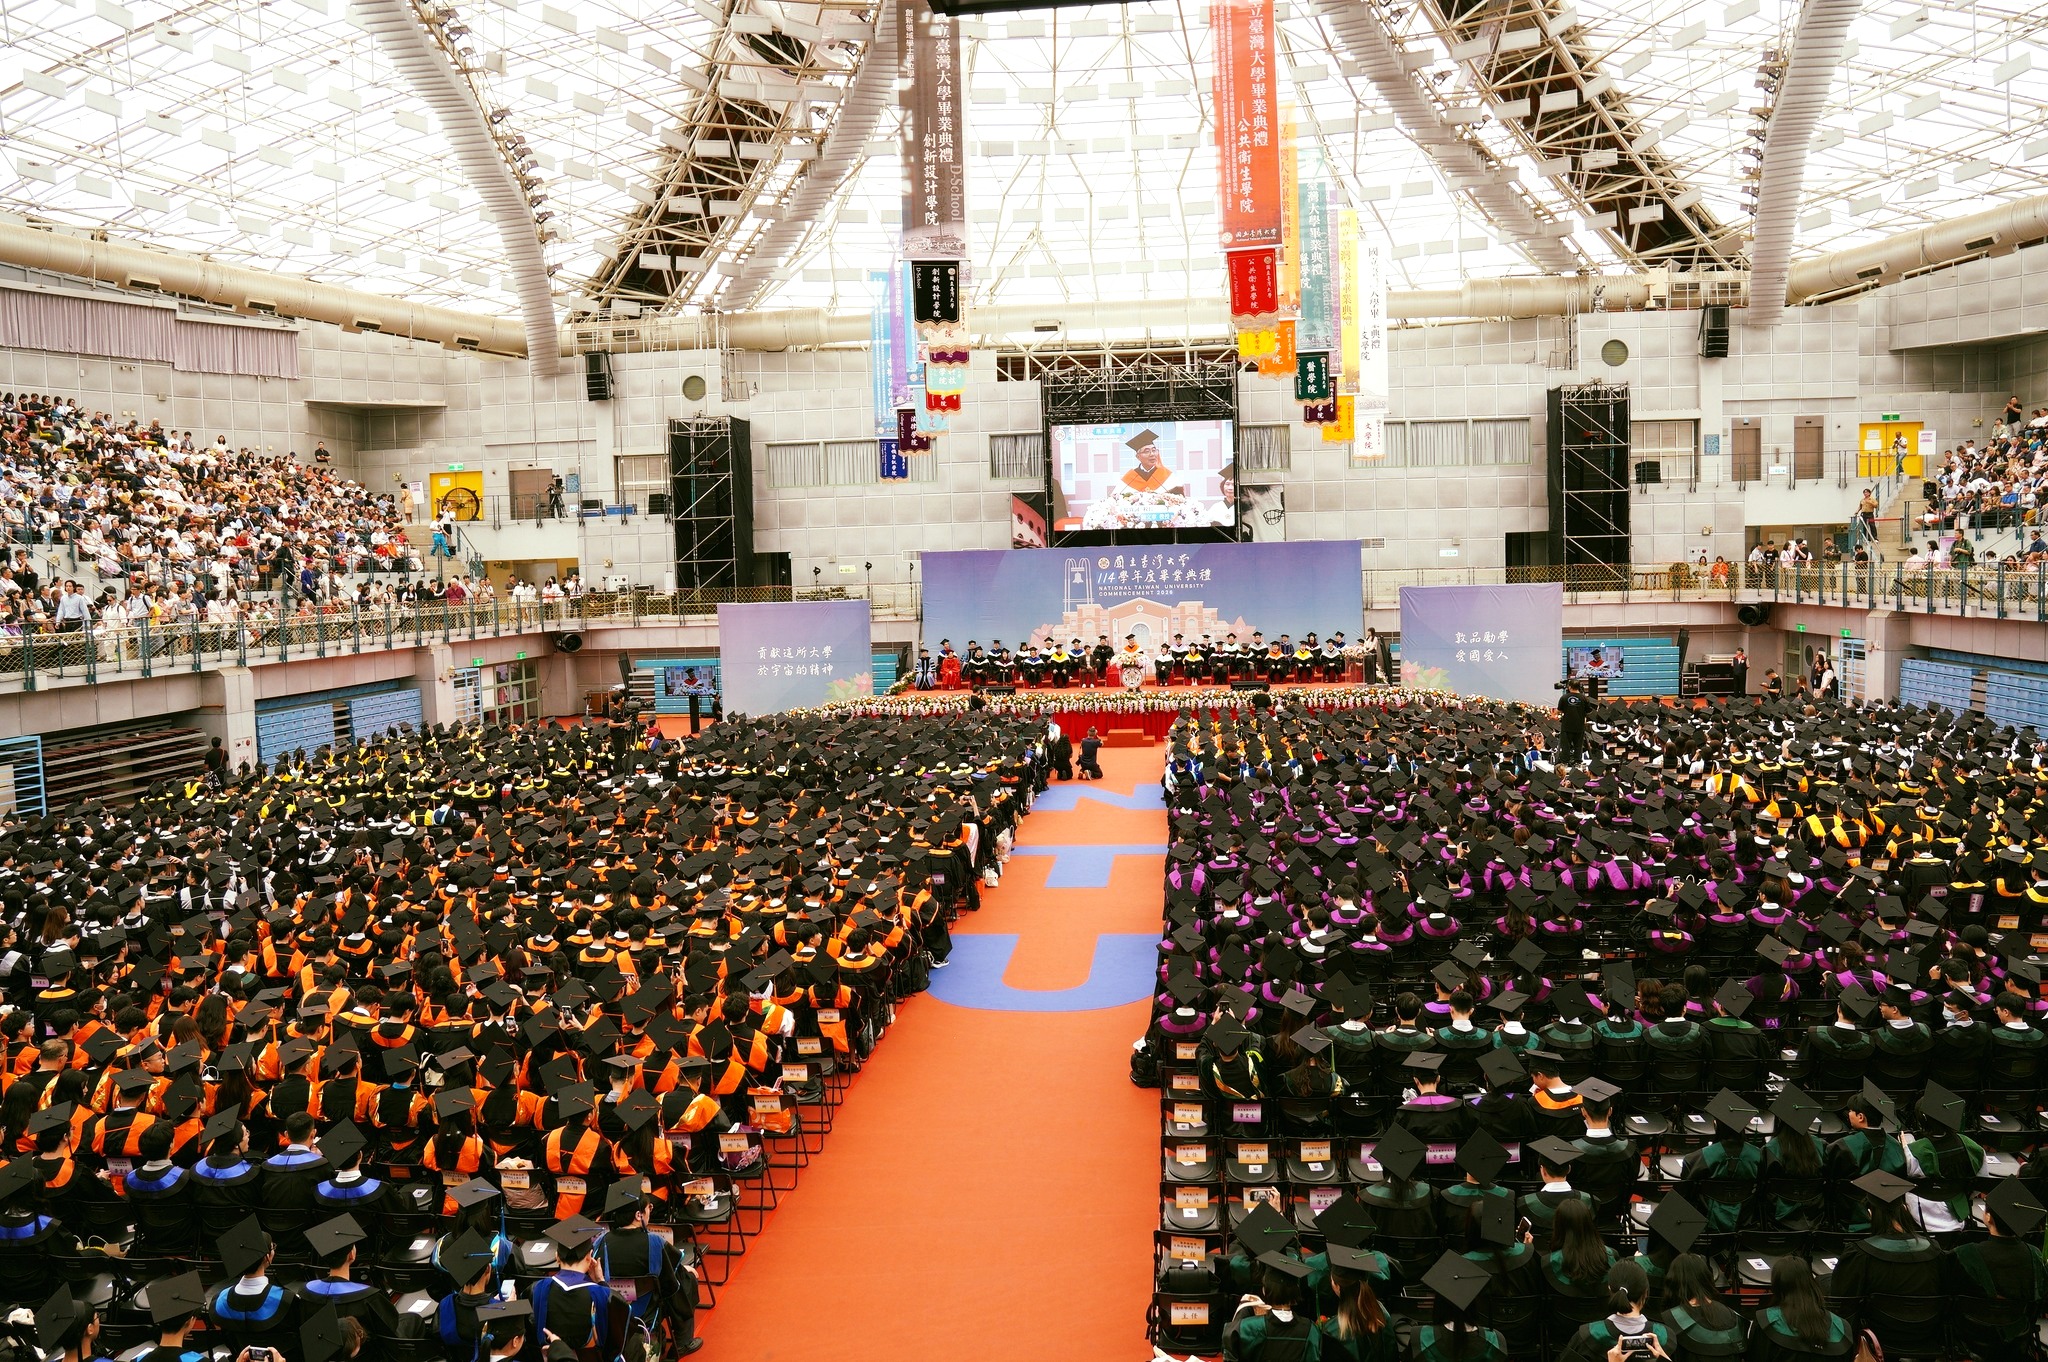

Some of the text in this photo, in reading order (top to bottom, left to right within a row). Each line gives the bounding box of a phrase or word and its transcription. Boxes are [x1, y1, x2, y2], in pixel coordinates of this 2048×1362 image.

[1247, 0, 1269, 147] 立臺灣大學畢業典禮
[949, 164, 964, 222] D-School
[1248, 258, 1259, 309] 公共衛生學院
[931, 267, 941, 318] 創新設計學院
[1306, 360, 1318, 394] 醫學院
[1113, 553, 1190, 569] 國立臺灣大學
[1097, 568, 1212, 584] 114學年度畢業典禮
[1454, 630, 1509, 644] 敦品勵學
[757, 645, 833, 660] 貢獻這所大學
[1455, 649, 1509, 663] 愛國愛人
[757, 663, 834, 677] 於宇宙的精神
[1181, 1312, 1198, 1320] 主任
